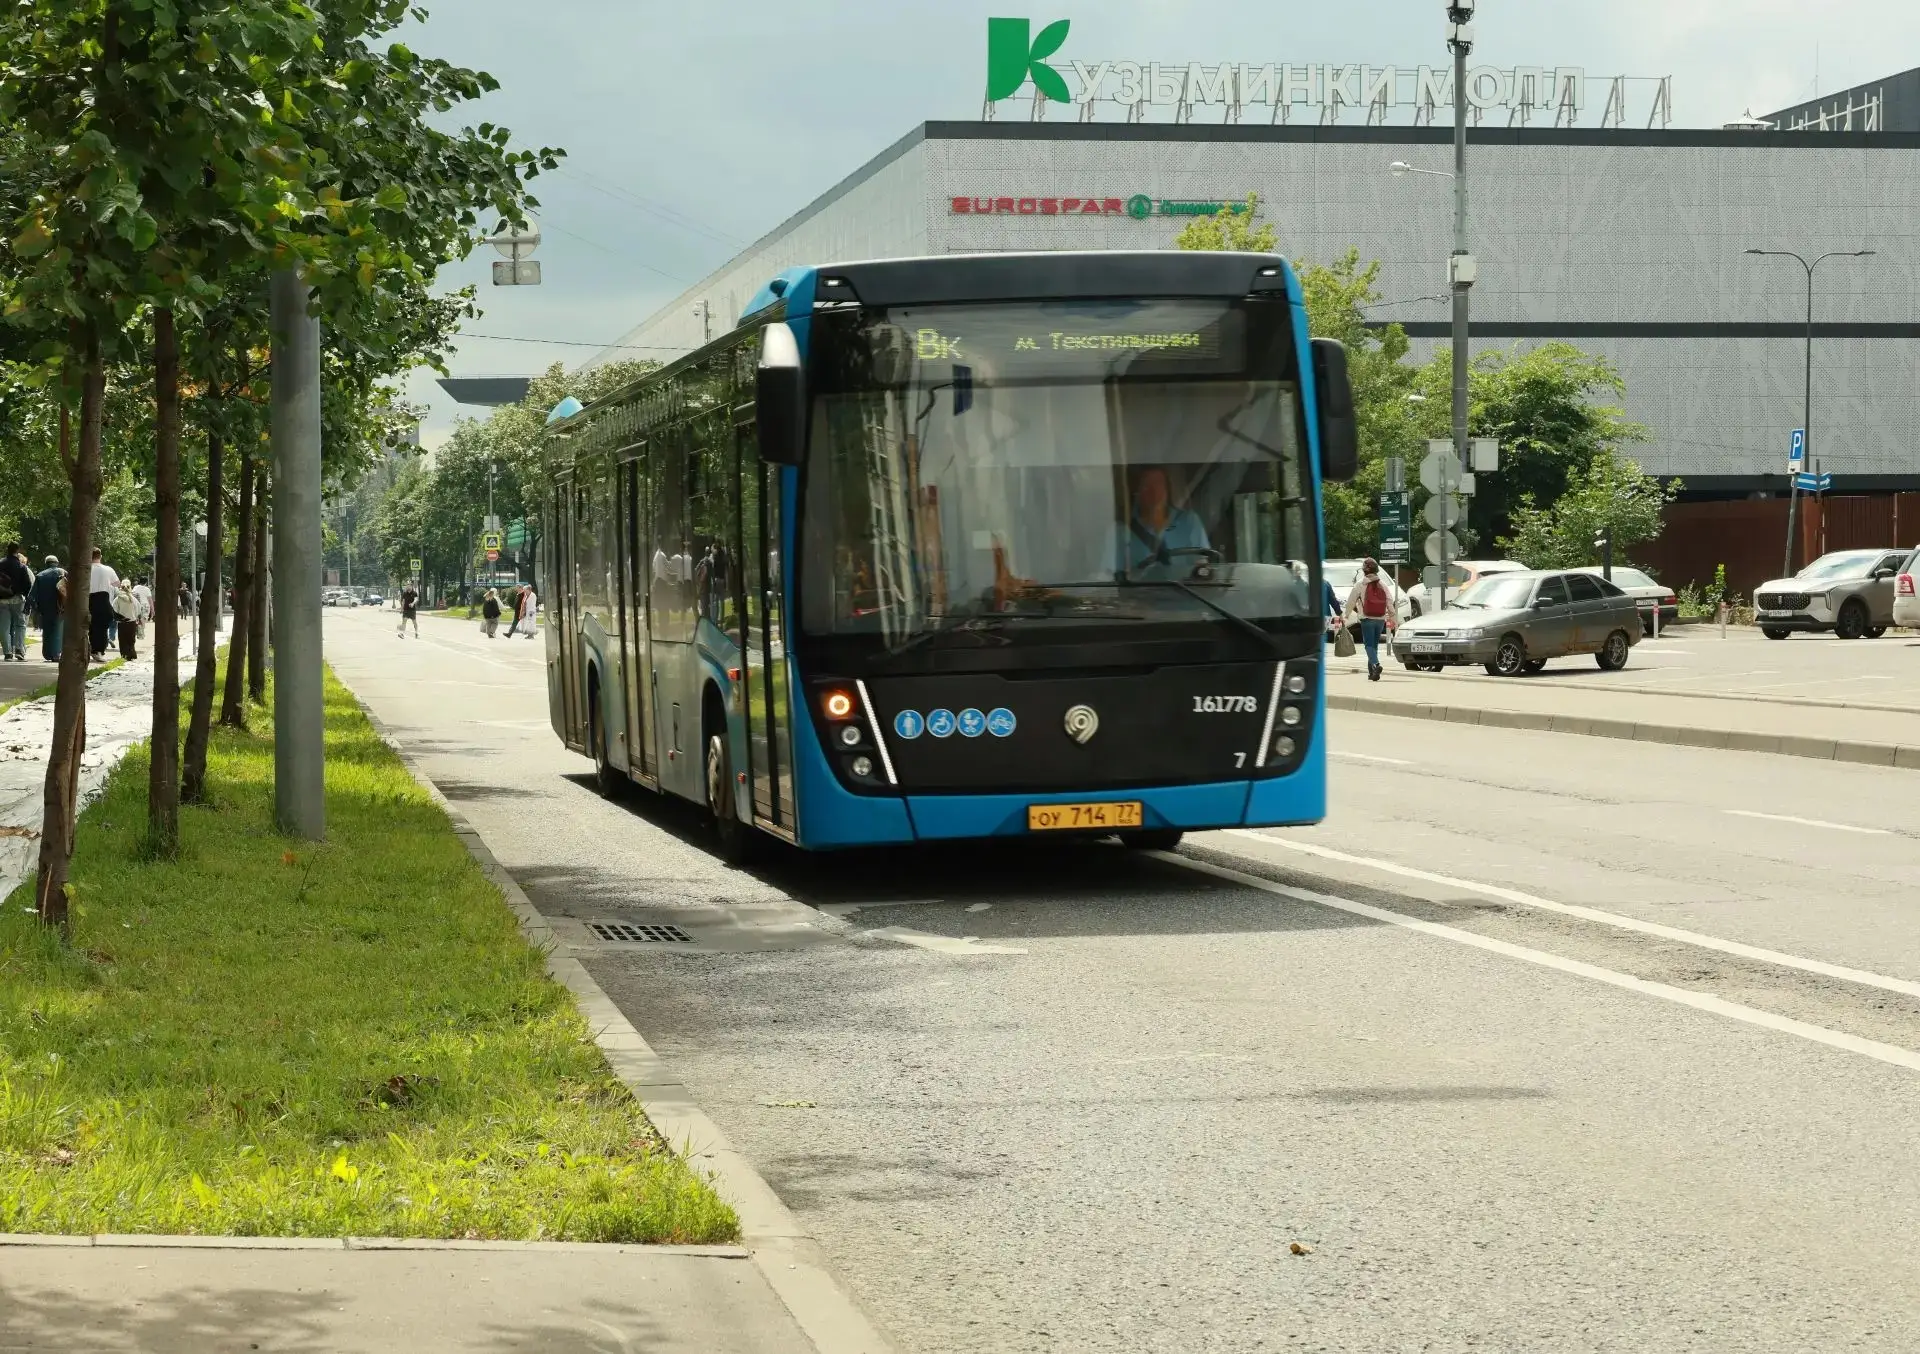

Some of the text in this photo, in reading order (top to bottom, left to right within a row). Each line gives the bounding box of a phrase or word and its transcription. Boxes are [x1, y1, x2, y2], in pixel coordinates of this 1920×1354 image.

[1415, 64, 1585, 111] МОЛЛ
[951, 196, 1123, 215] EUROSPAR
[1192, 695, 1258, 713] 161778
[1232, 751, 1248, 769] 7
[1070, 806, 1106, 826] 714
[1116, 804, 1135, 819] 77
